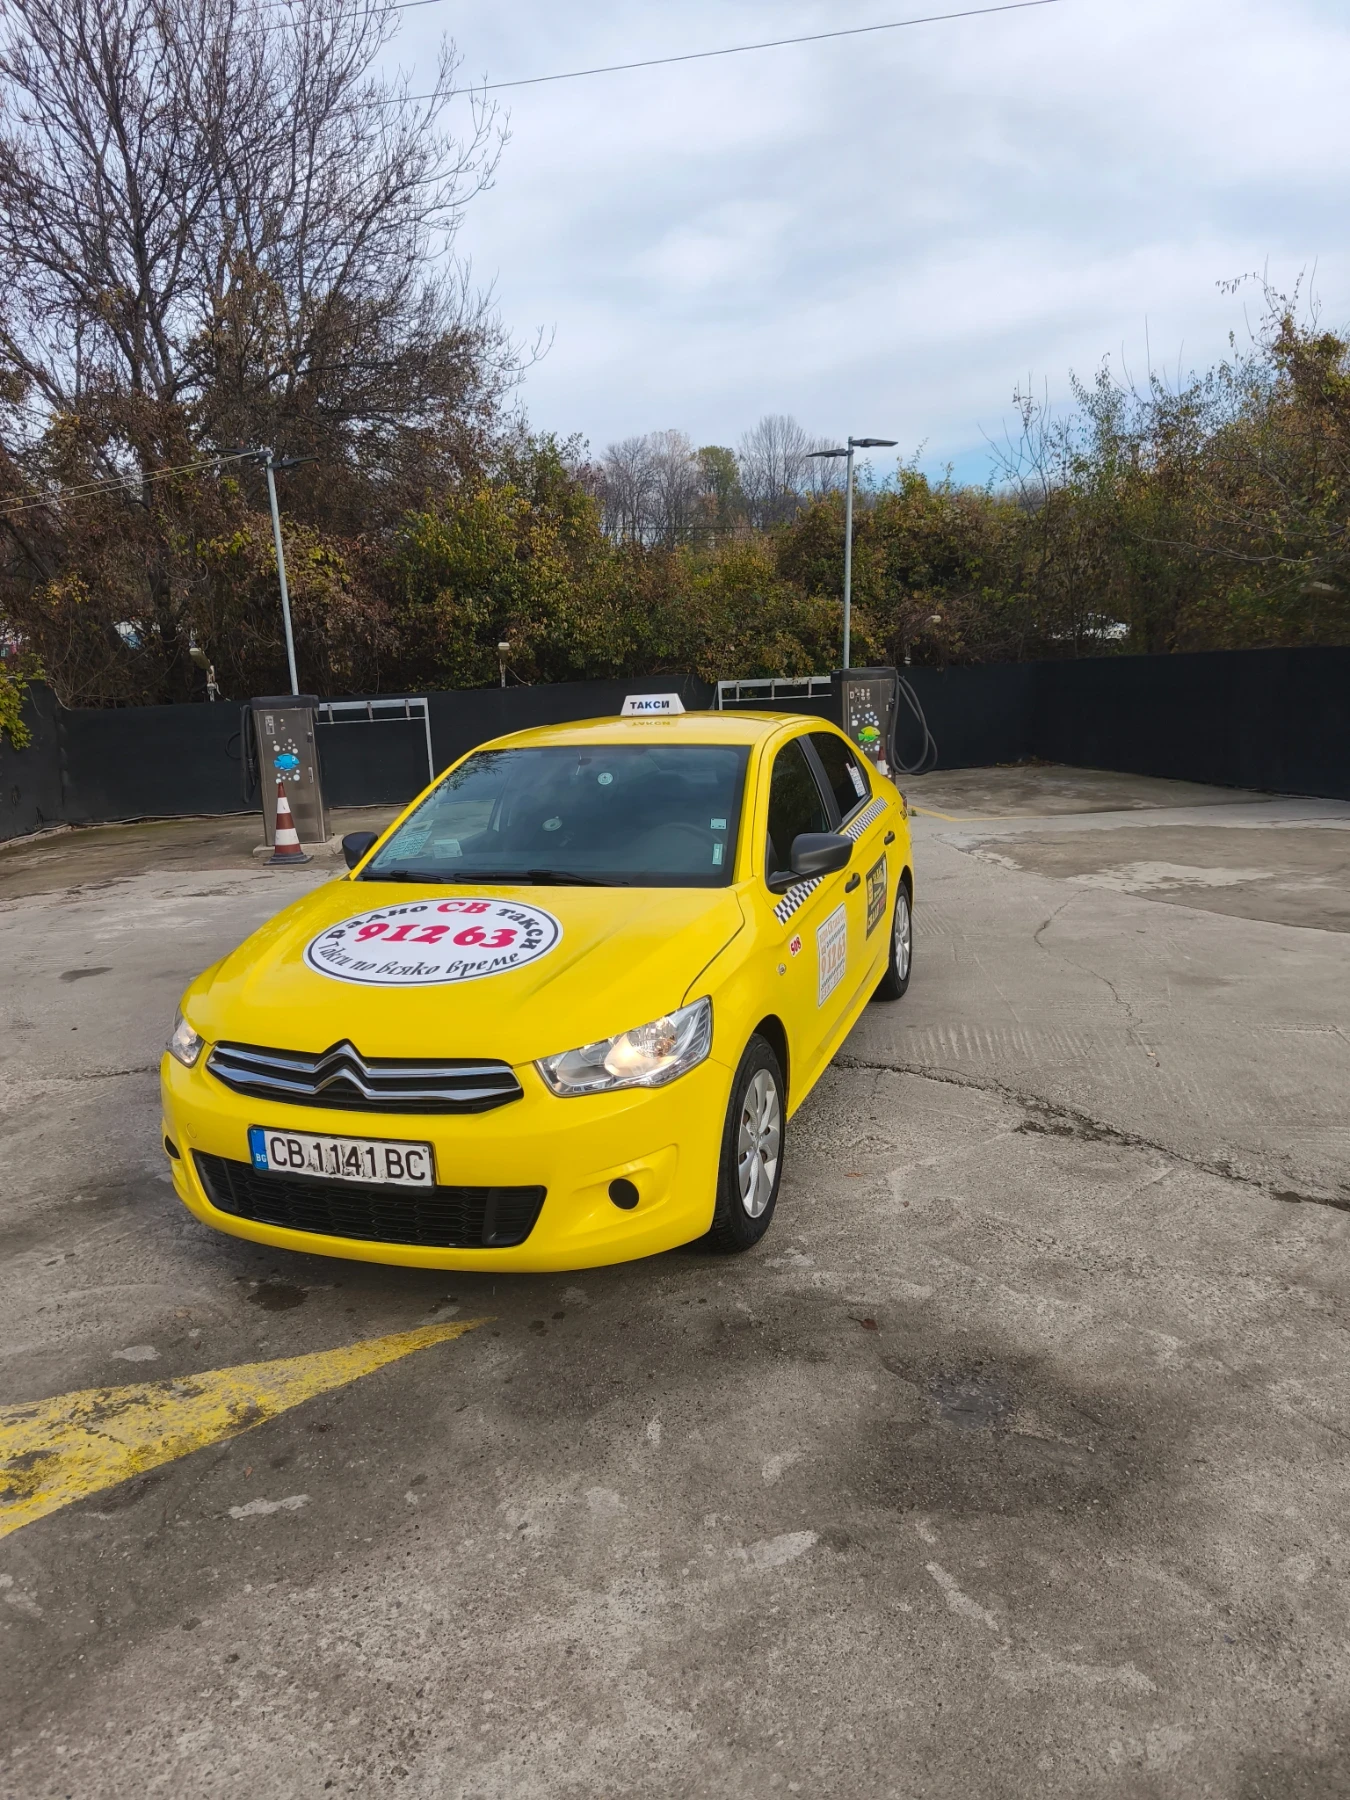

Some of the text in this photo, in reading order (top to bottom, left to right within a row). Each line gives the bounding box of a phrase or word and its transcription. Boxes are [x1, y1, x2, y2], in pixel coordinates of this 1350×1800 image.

[630, 700, 670, 710] ТАКСИ
[318, 941, 519, 976] Такси по всяко време
[256, 1153, 267, 1163] BG
